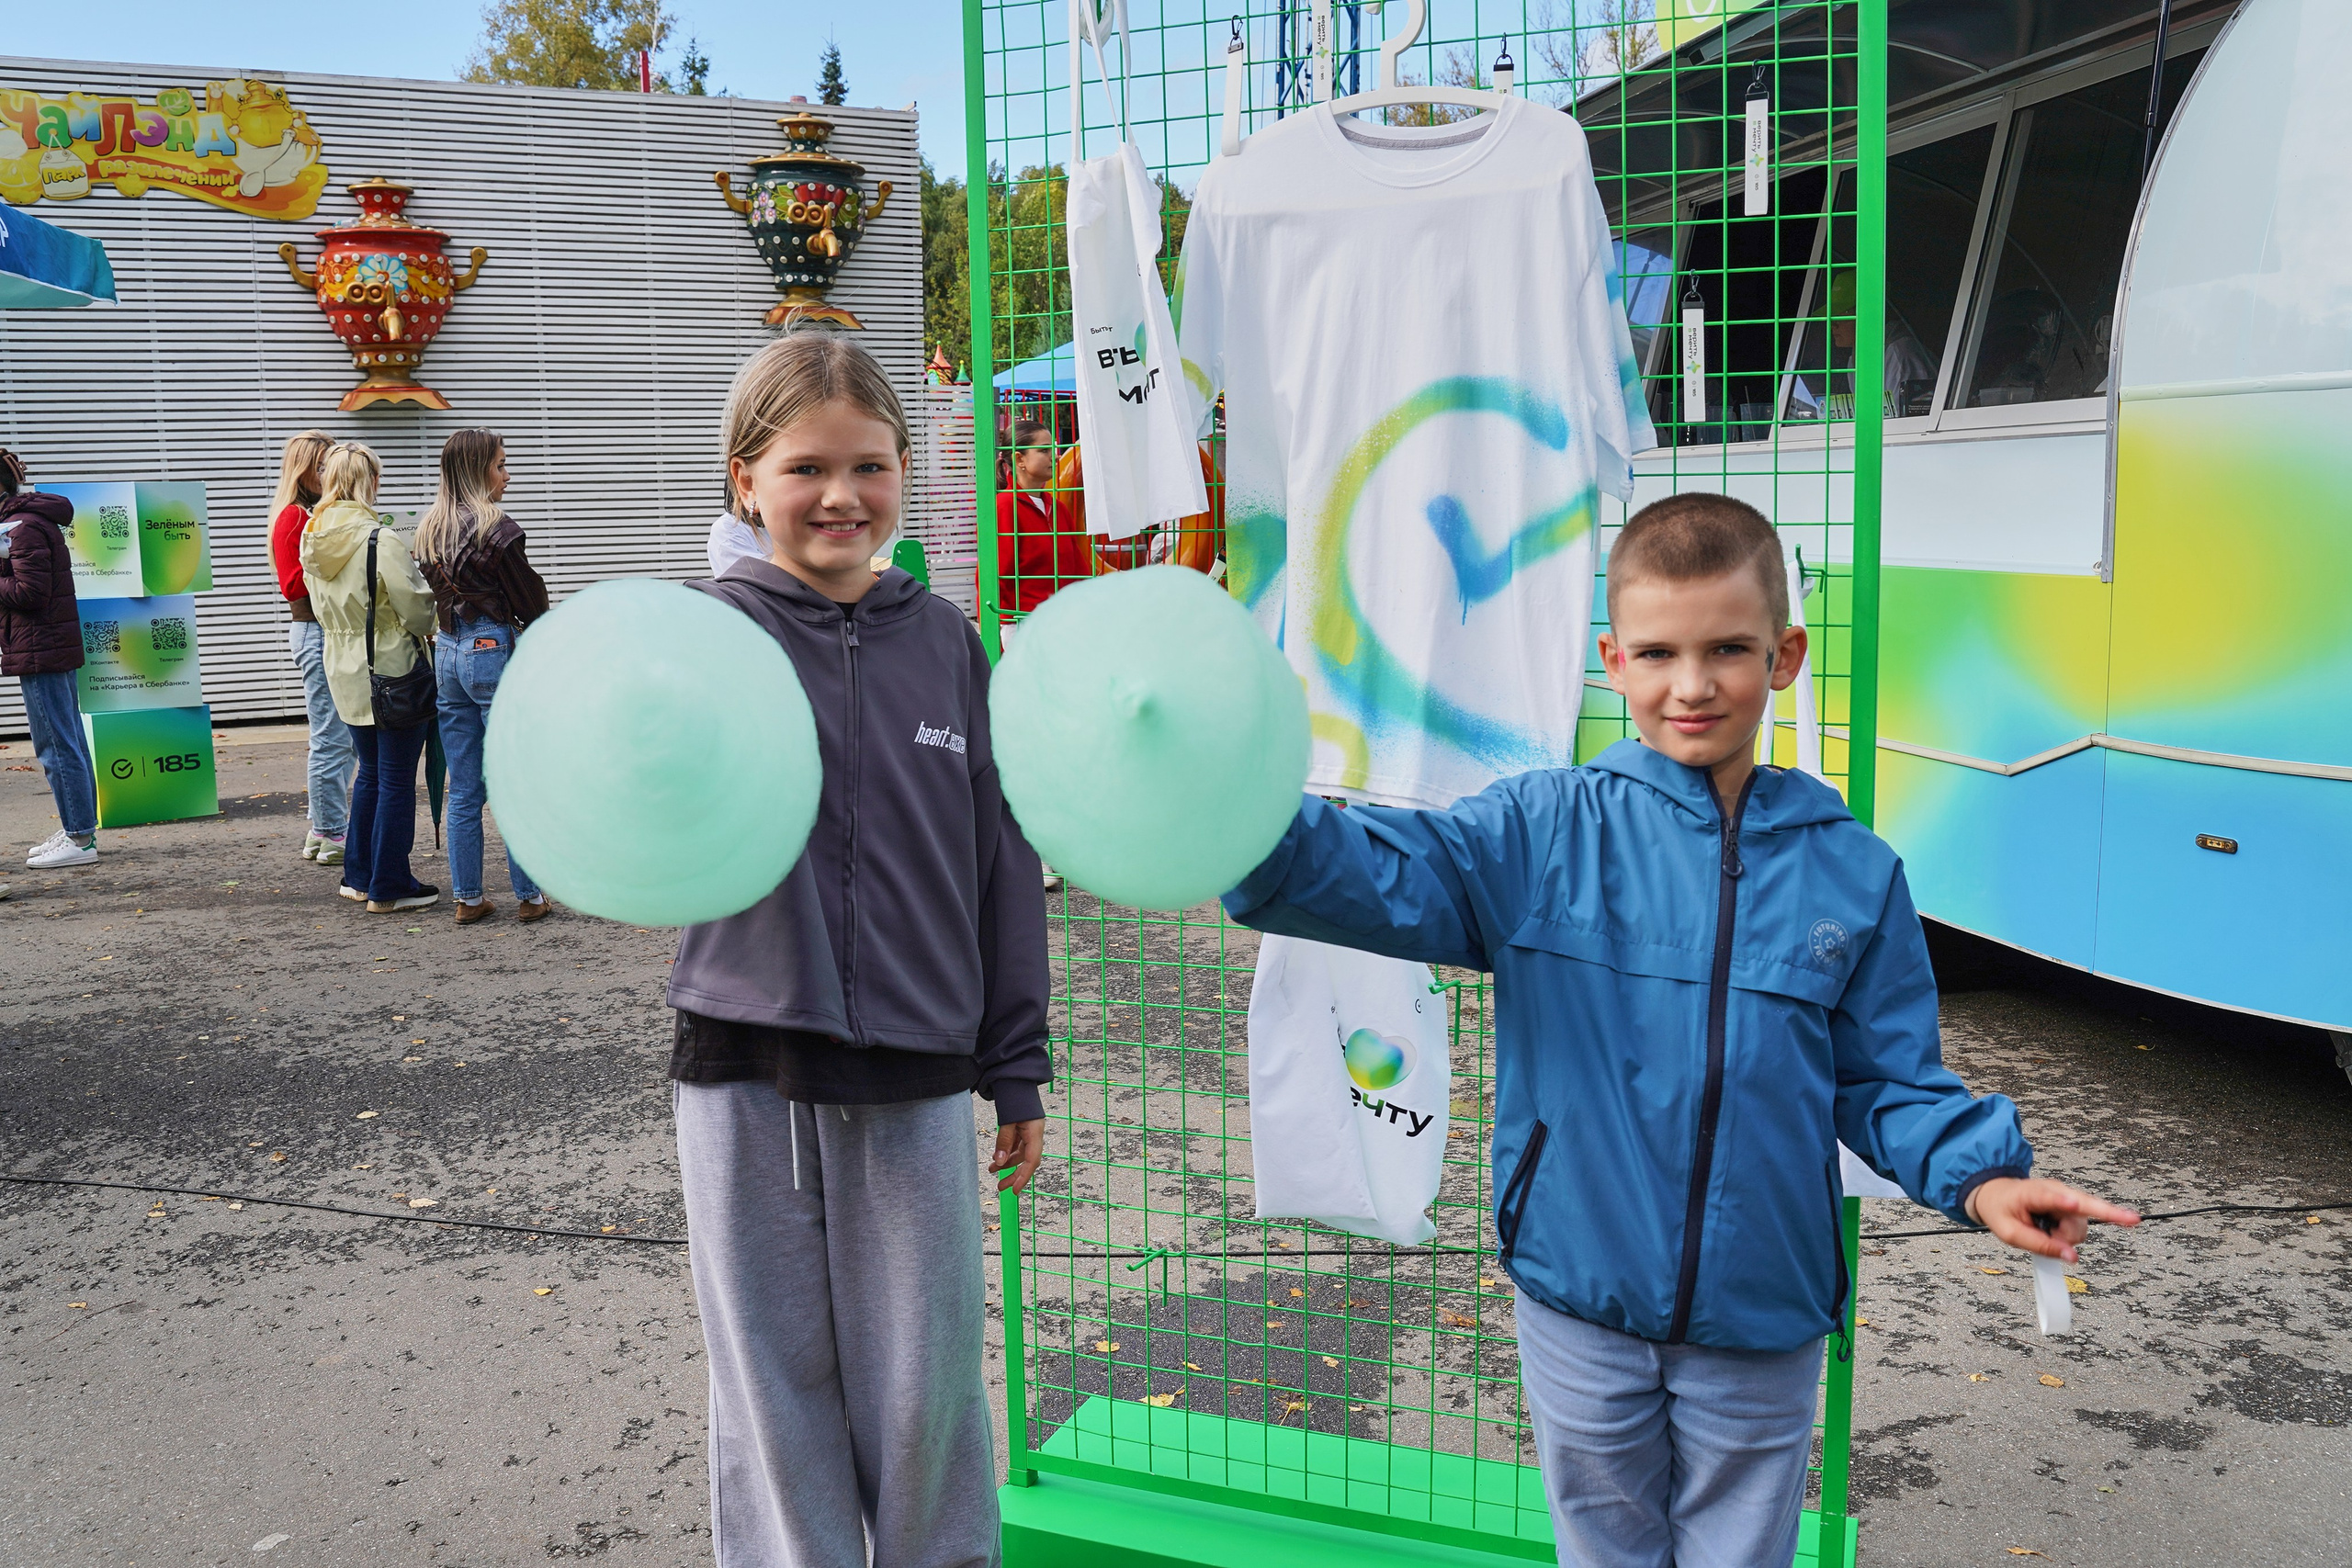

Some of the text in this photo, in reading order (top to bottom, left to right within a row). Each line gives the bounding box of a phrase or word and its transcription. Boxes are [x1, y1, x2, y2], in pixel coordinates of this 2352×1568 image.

[145, 519, 195, 530] Зелёным
[164, 530, 191, 540] быть
[89, 673, 145, 683] Подписывайся
[153, 753, 200, 773] 185
[1814, 923, 1846, 942] FUTURINO
